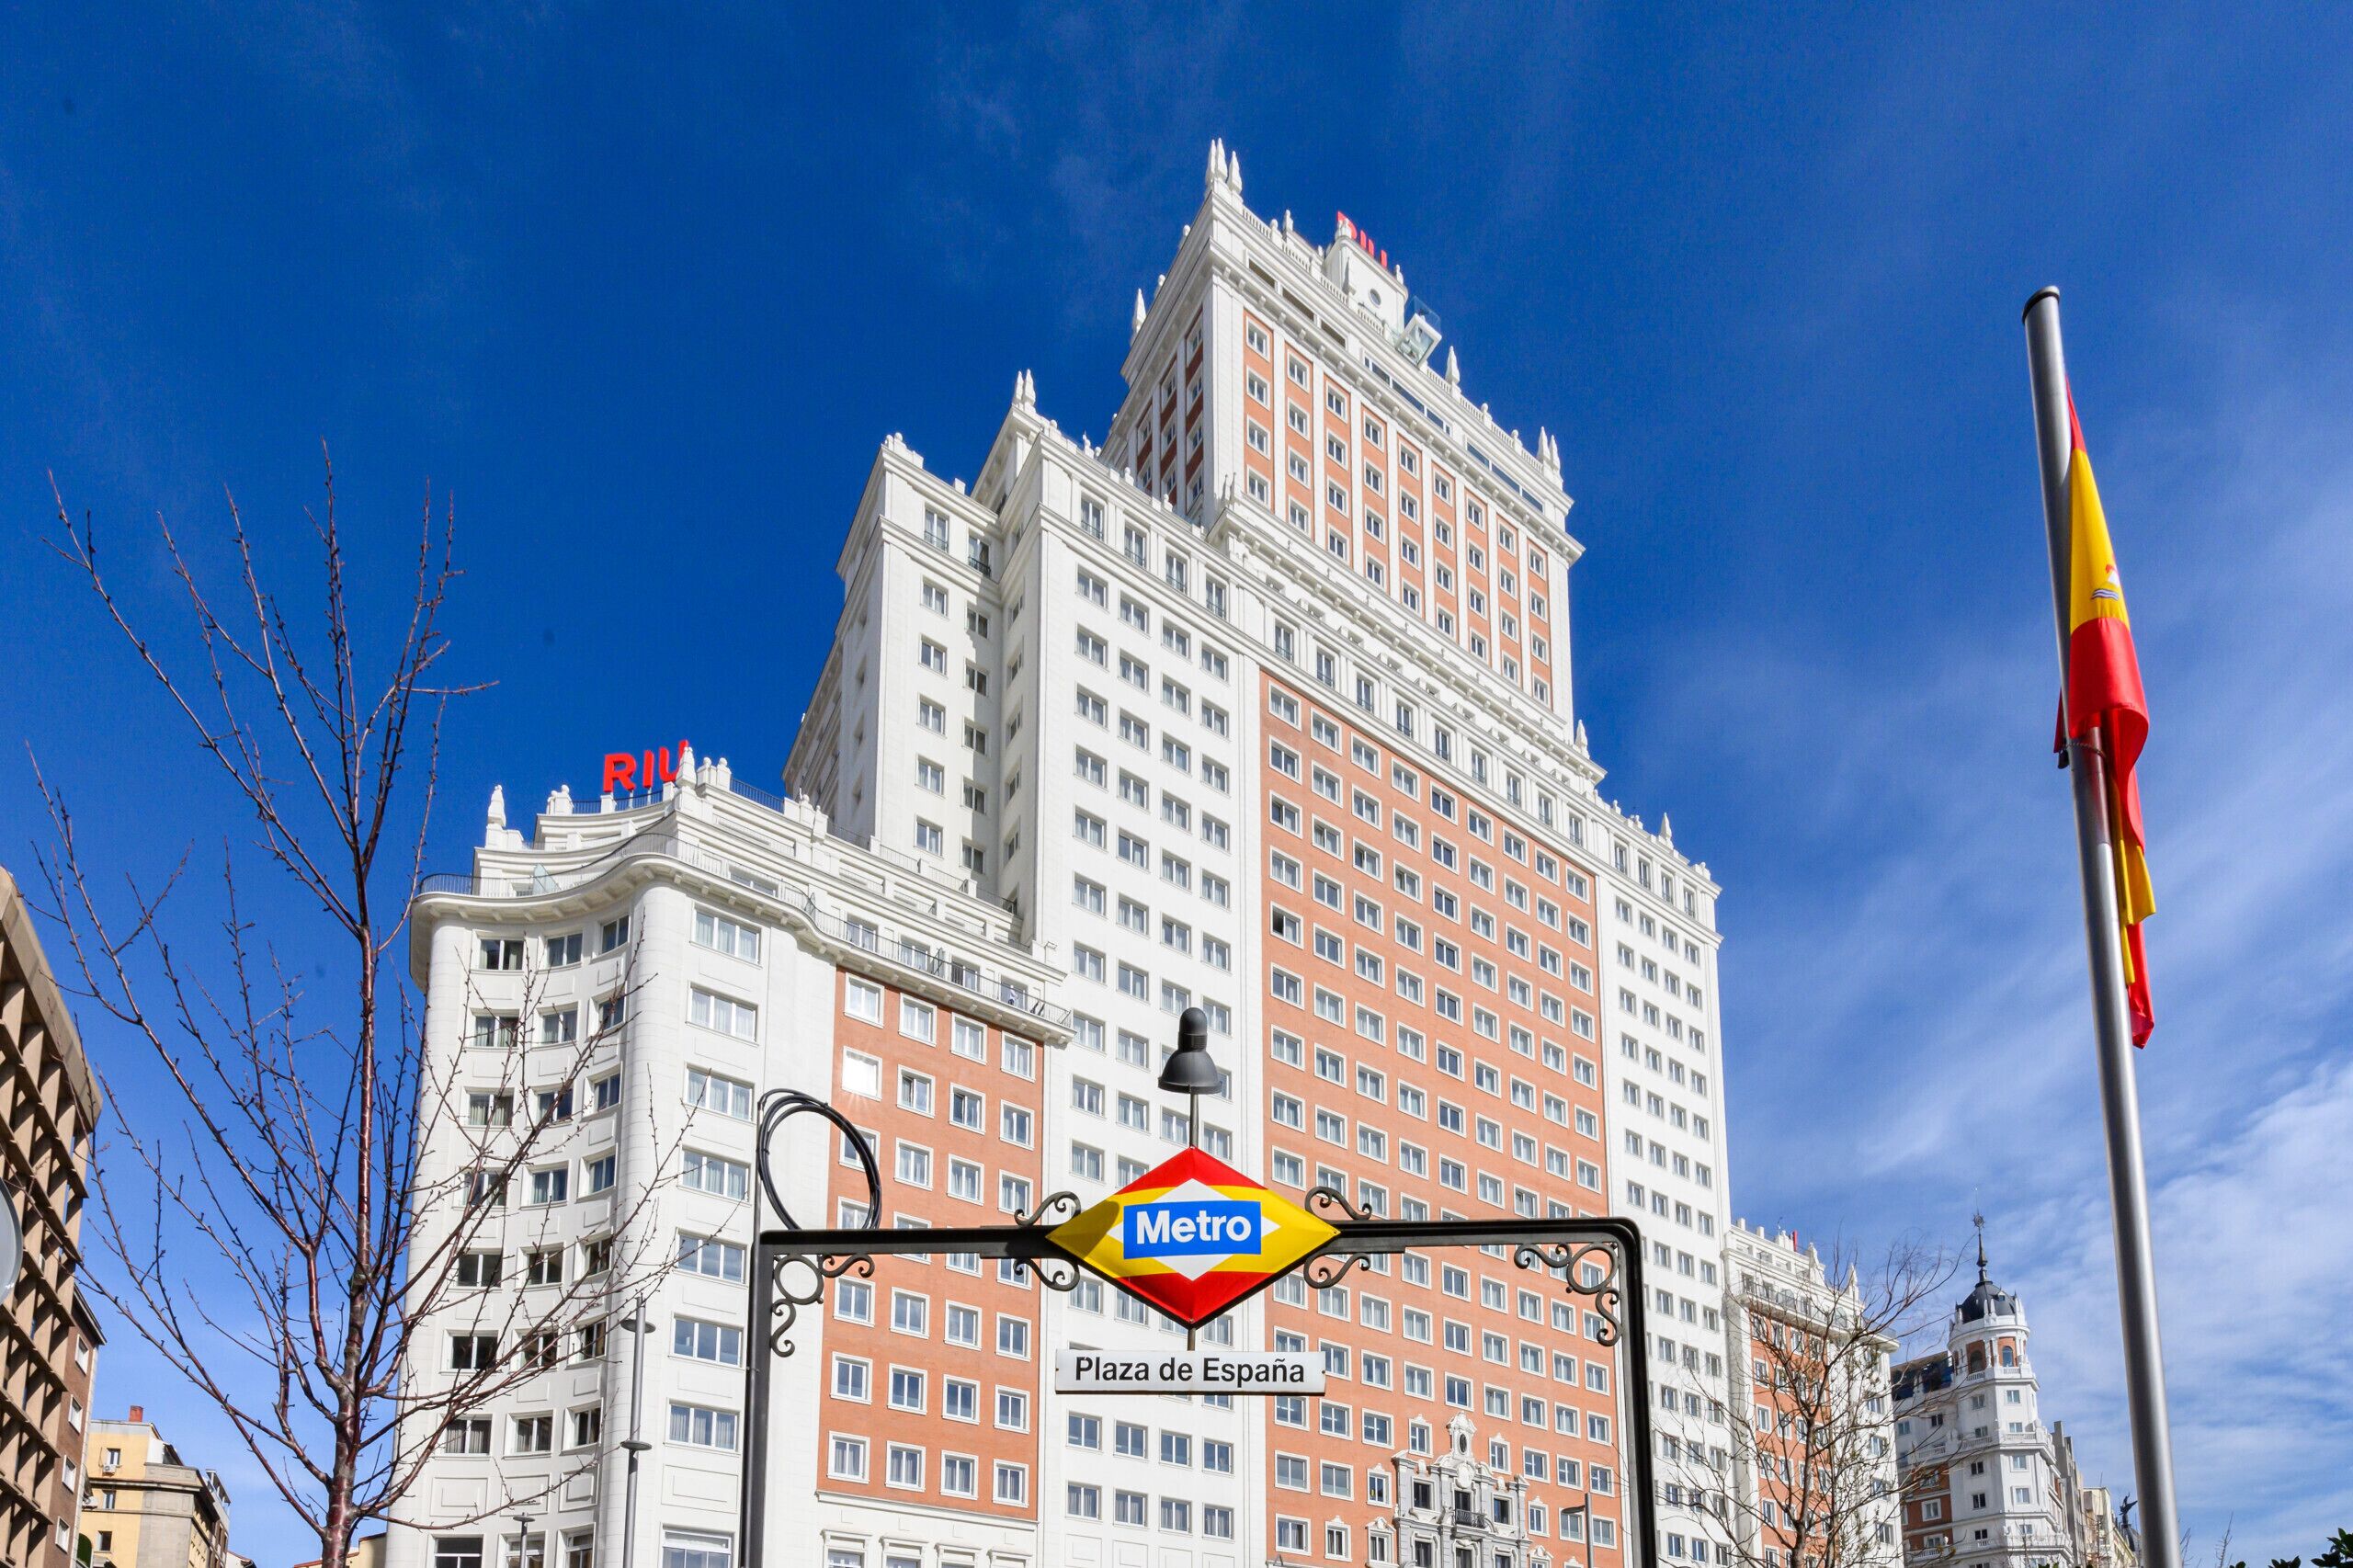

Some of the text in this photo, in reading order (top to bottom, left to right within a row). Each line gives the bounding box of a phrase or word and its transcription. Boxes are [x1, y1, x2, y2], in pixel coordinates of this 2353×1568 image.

[603, 738, 689, 793] RIU
[1136, 1210, 1252, 1244] Metro
[1074, 1356, 1305, 1389] Plaza de España
